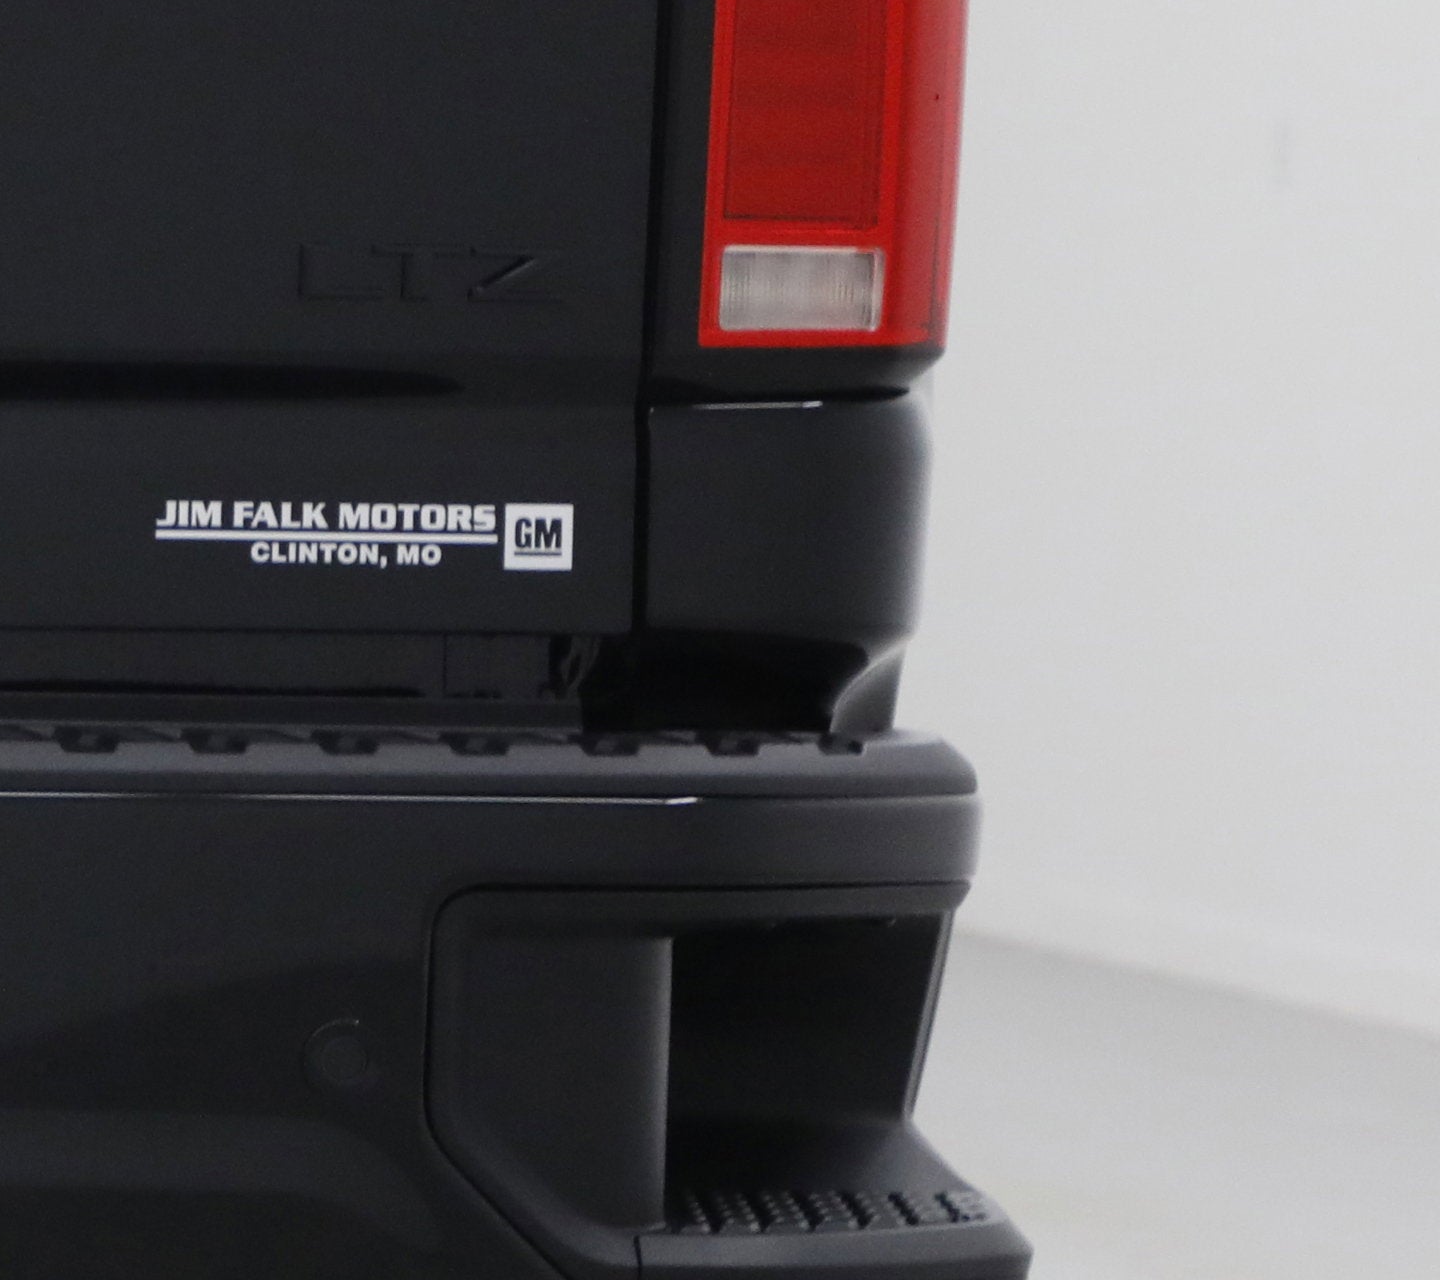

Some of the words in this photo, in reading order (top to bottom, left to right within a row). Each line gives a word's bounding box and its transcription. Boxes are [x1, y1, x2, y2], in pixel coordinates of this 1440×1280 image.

[296, 241, 565, 305] LTZ
[156, 500, 223, 528] JIM
[233, 501, 329, 530] FALK
[338, 503, 497, 533] MOTORS
[514, 518, 563, 550] GM
[250, 541, 388, 570] CLINTON,
[396, 544, 442, 567] MO
